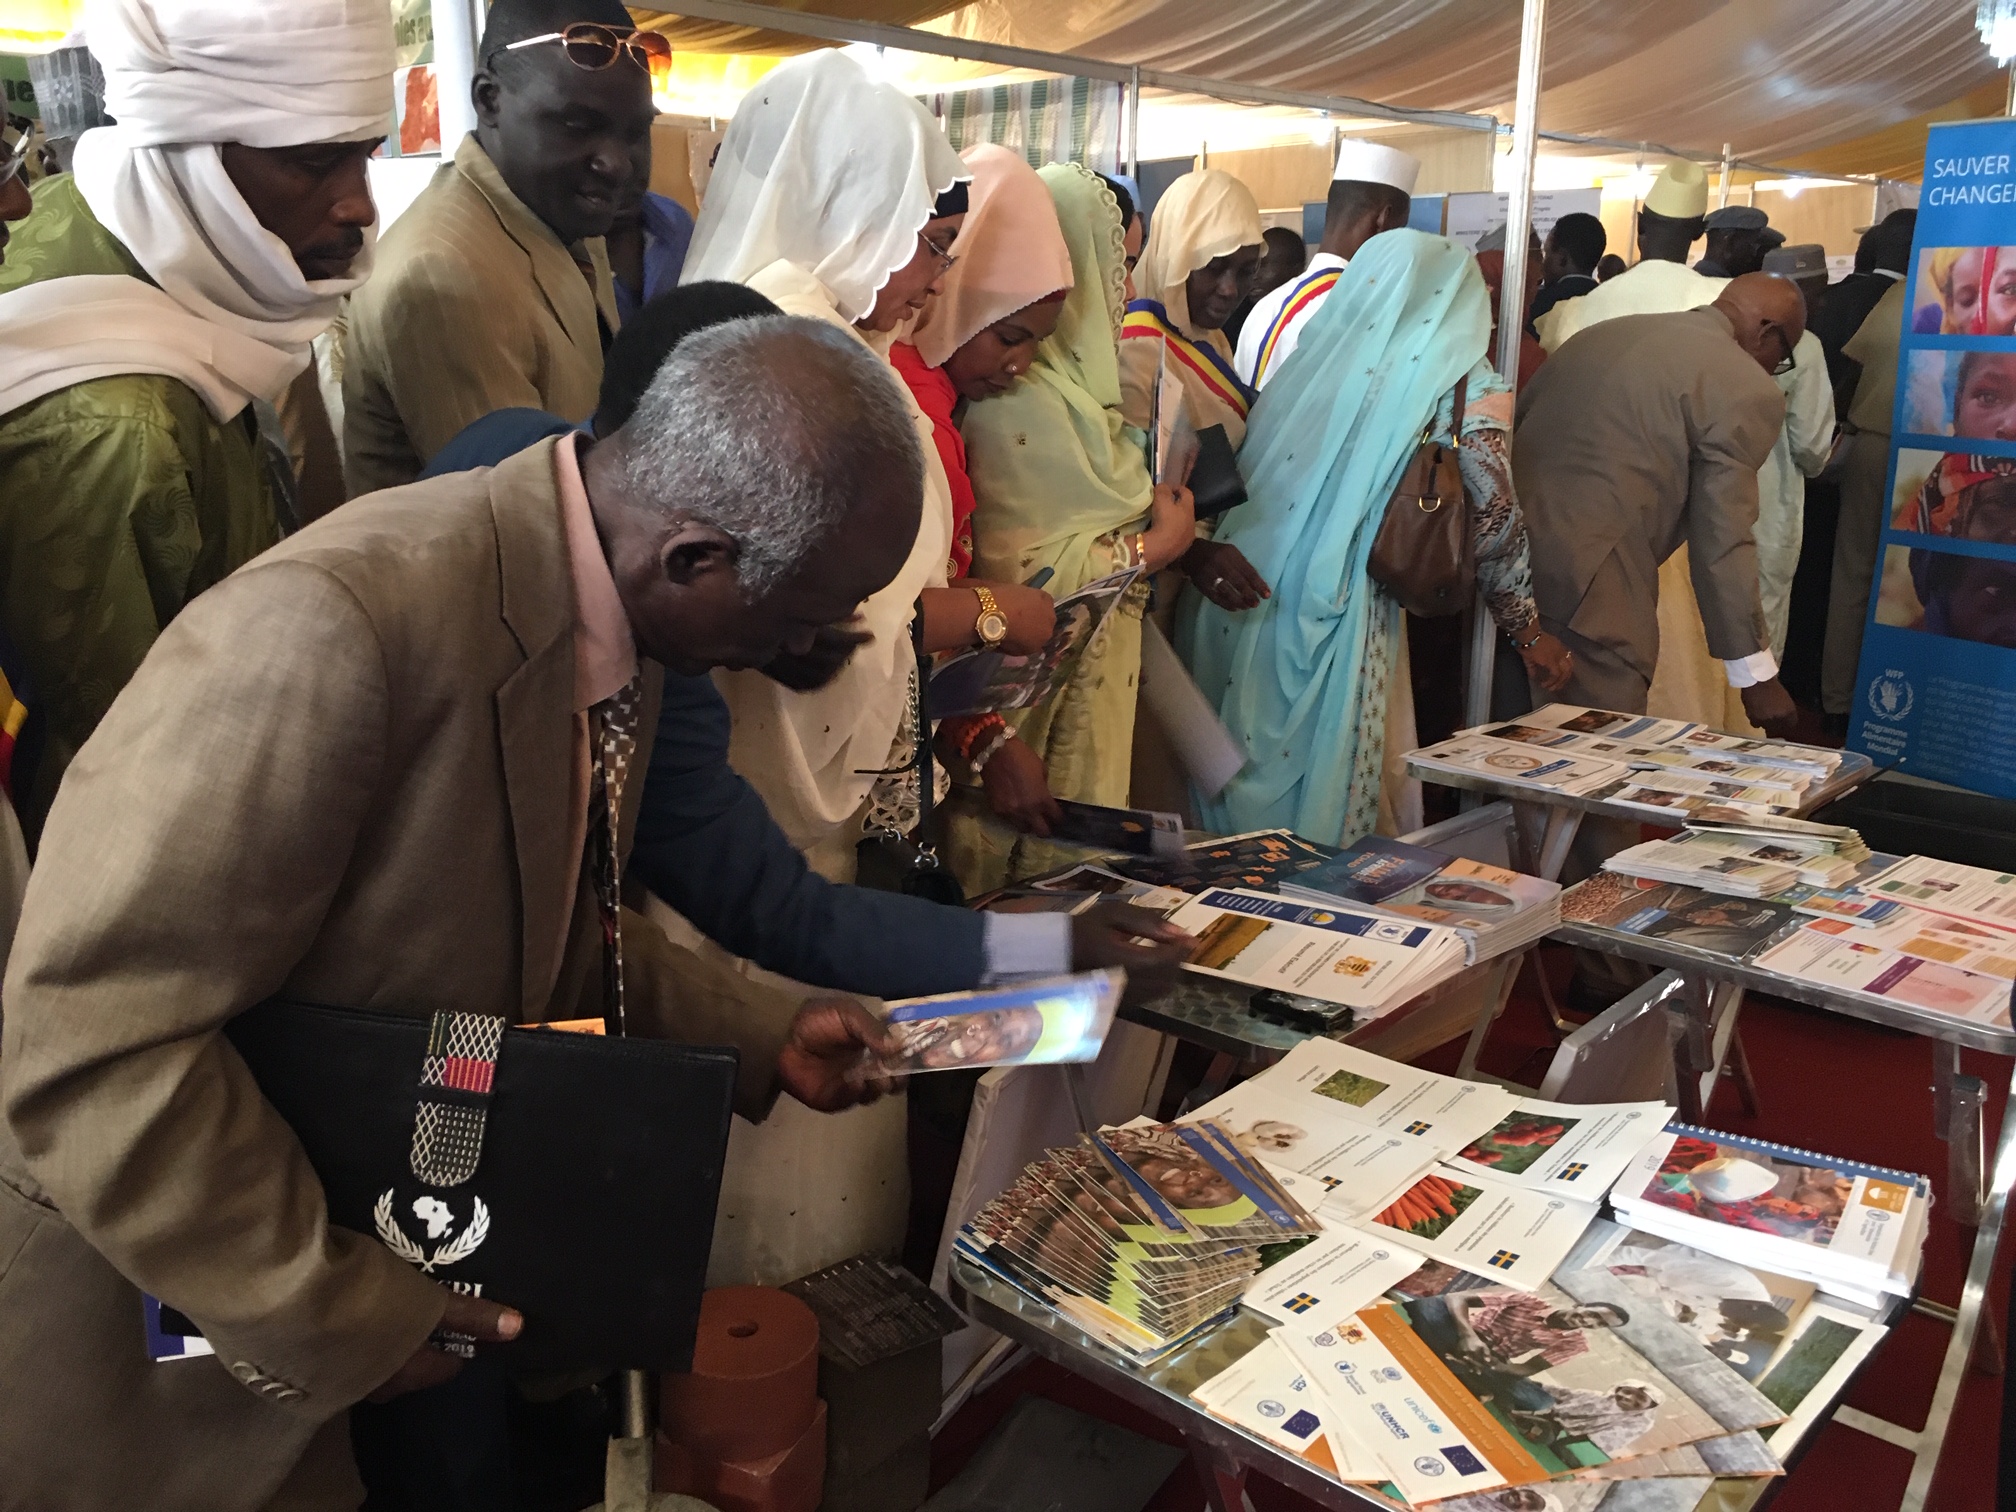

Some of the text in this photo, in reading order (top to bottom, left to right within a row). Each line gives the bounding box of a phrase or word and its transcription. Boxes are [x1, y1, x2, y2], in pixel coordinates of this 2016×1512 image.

[1932, 155, 2010, 178] SAUVER
[1929, 184, 2016, 206] CHANGE
[1861, 730, 1906, 748] Alimentaire
[1863, 720, 1908, 738] Programme
[1867, 742, 1899, 756] Mondial
[1643, 1155, 1663, 1172] 2019
[1403, 1397, 1432, 1424] unicef
[1382, 1410, 1410, 1439] UNHCR
